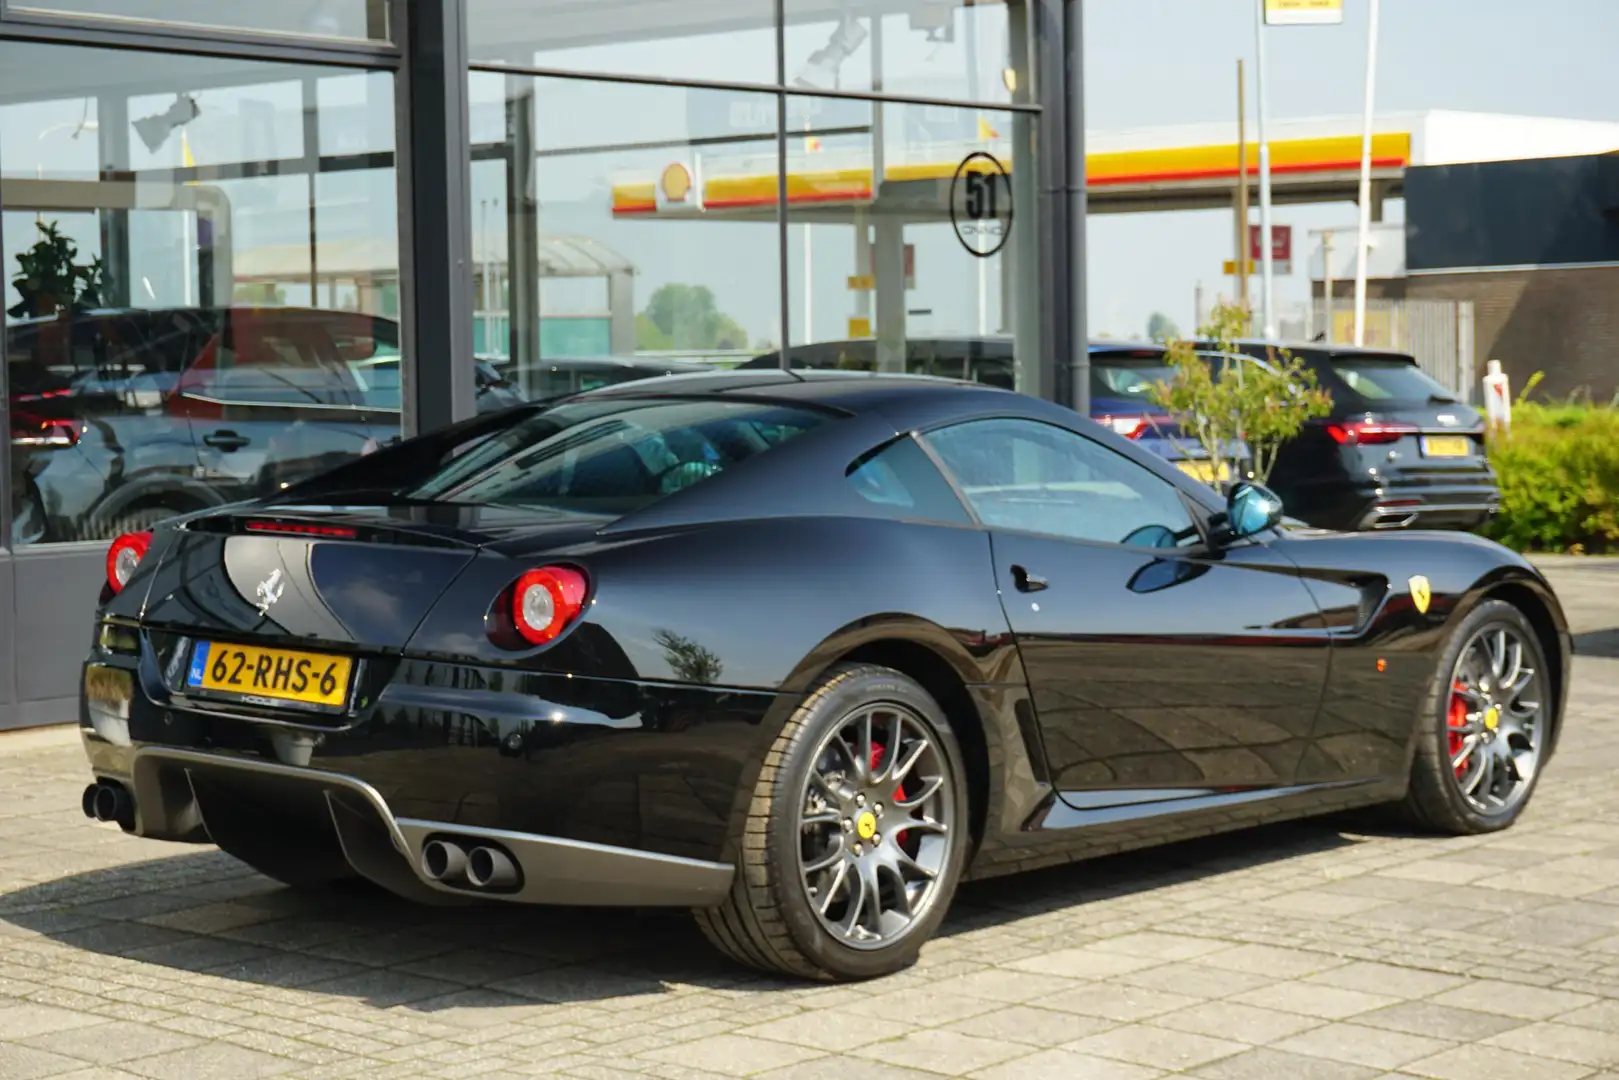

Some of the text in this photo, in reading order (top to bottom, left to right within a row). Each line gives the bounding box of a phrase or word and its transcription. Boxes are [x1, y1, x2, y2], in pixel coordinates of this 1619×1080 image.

[966, 170, 997, 219] 51
[191, 649, 338, 696] NL 62-RHS-6
